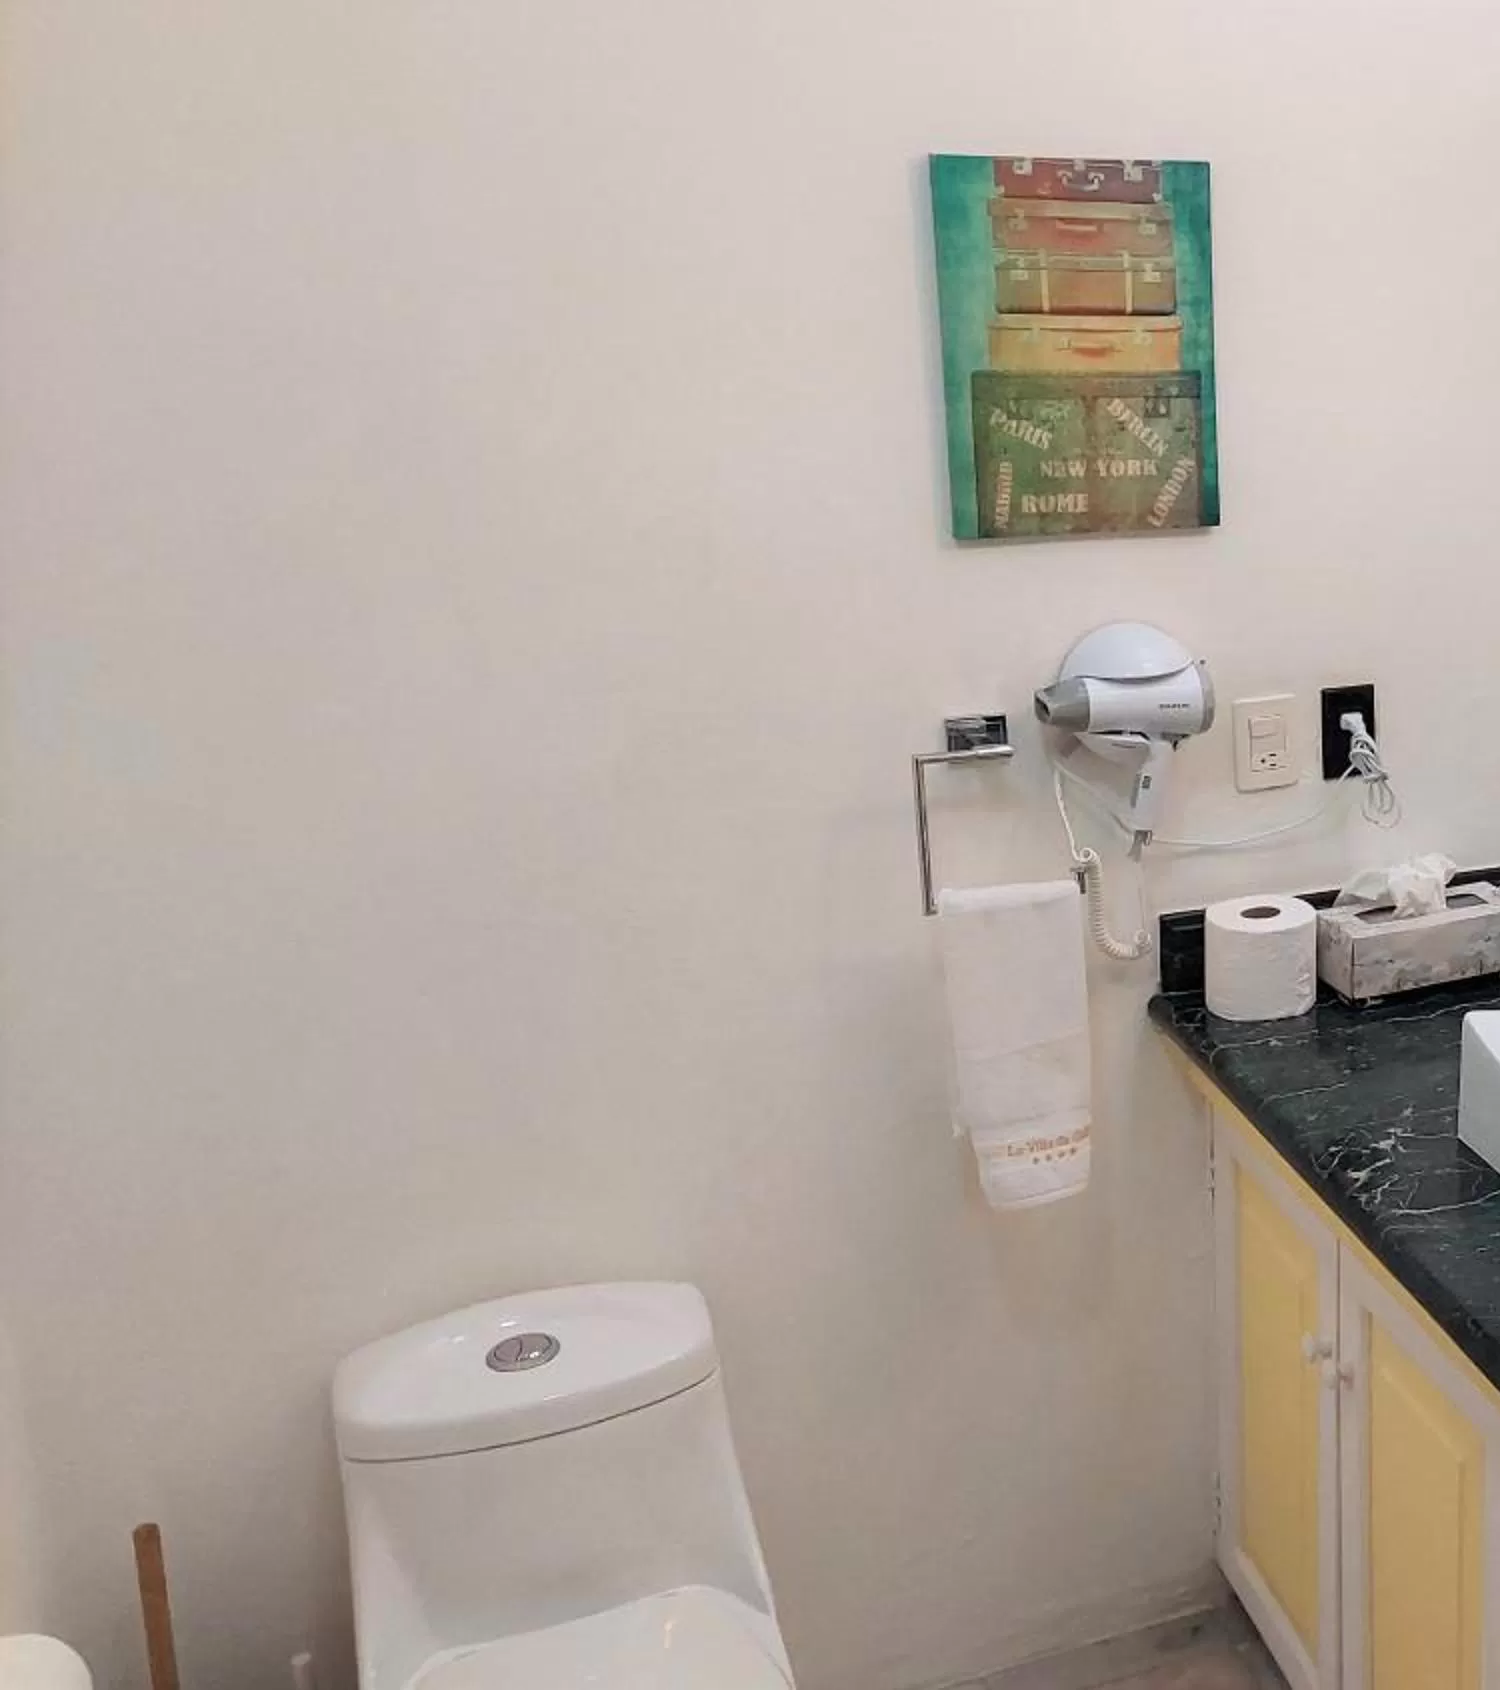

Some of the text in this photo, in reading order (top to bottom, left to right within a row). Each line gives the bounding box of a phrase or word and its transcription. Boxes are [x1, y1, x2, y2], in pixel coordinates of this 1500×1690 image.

[988, 408, 1053, 450] PARIS
[1106, 399, 1169, 456] BERLIN
[1040, 459, 1159, 478] NEW YORK
[1021, 493, 1089, 514] ROME
[1147, 455, 1195, 528] LONDON
